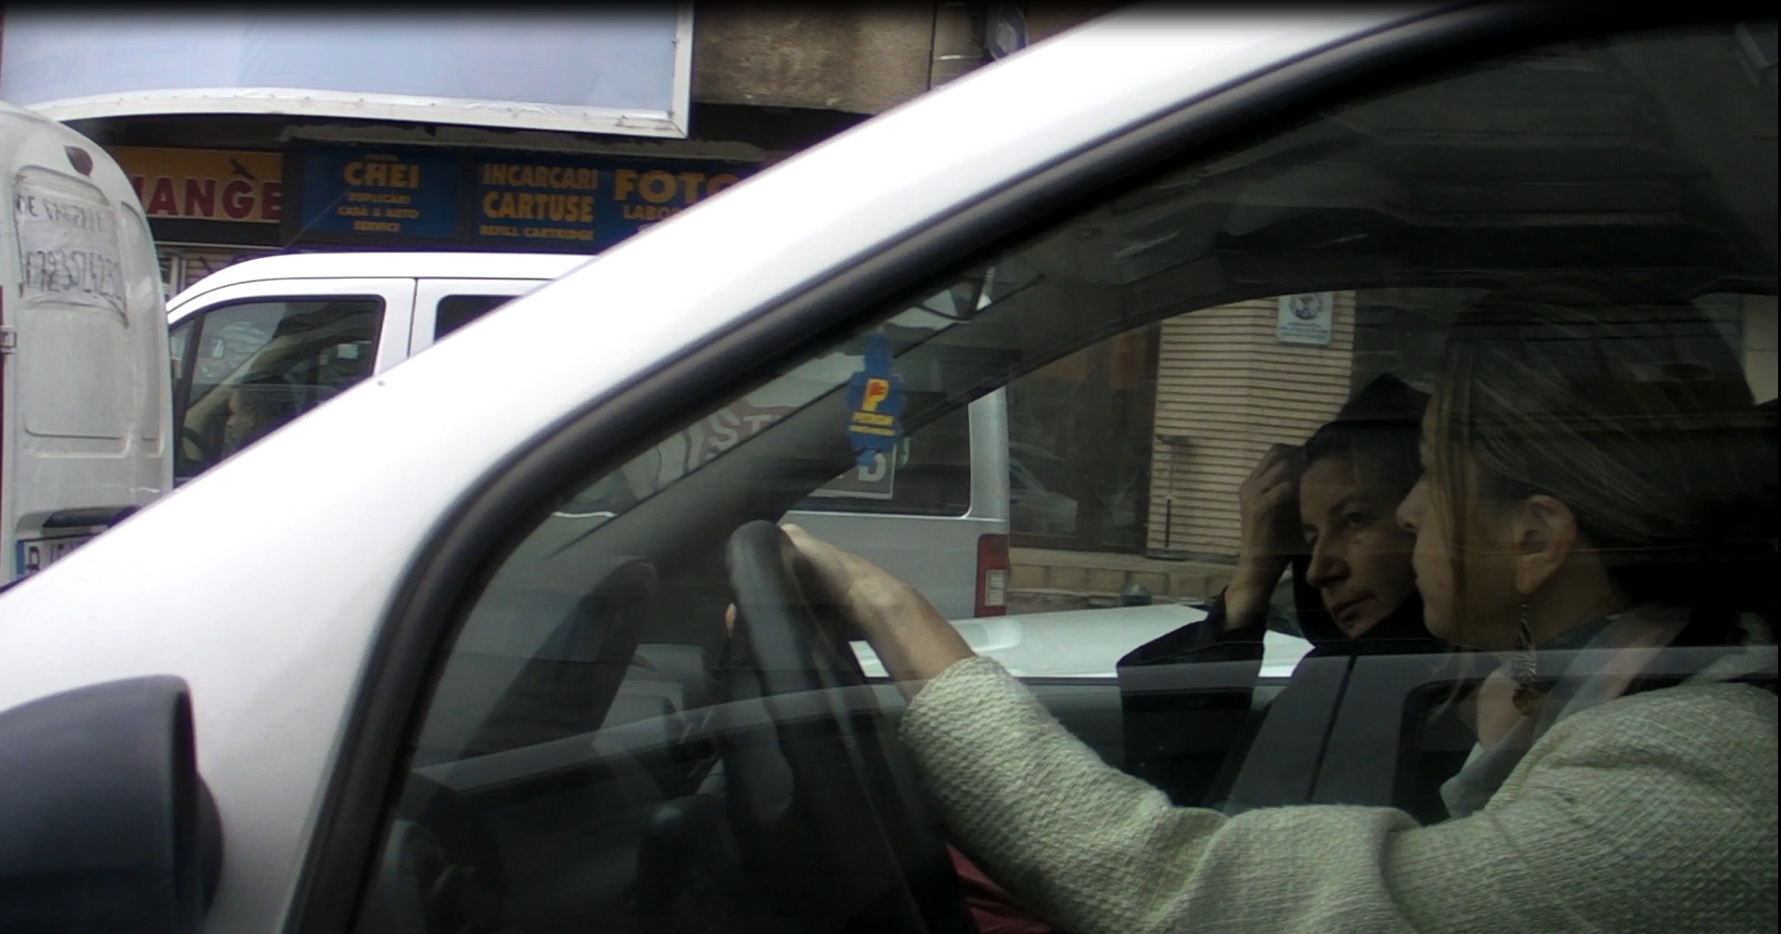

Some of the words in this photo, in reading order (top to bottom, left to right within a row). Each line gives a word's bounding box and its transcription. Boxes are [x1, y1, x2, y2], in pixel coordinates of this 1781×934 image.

[343, 160, 420, 188] CHEI
[482, 163, 598, 190] INCARCARI
[482, 191, 594, 222] CARTUSE
[523, 226, 595, 241] CARTRIDGE
